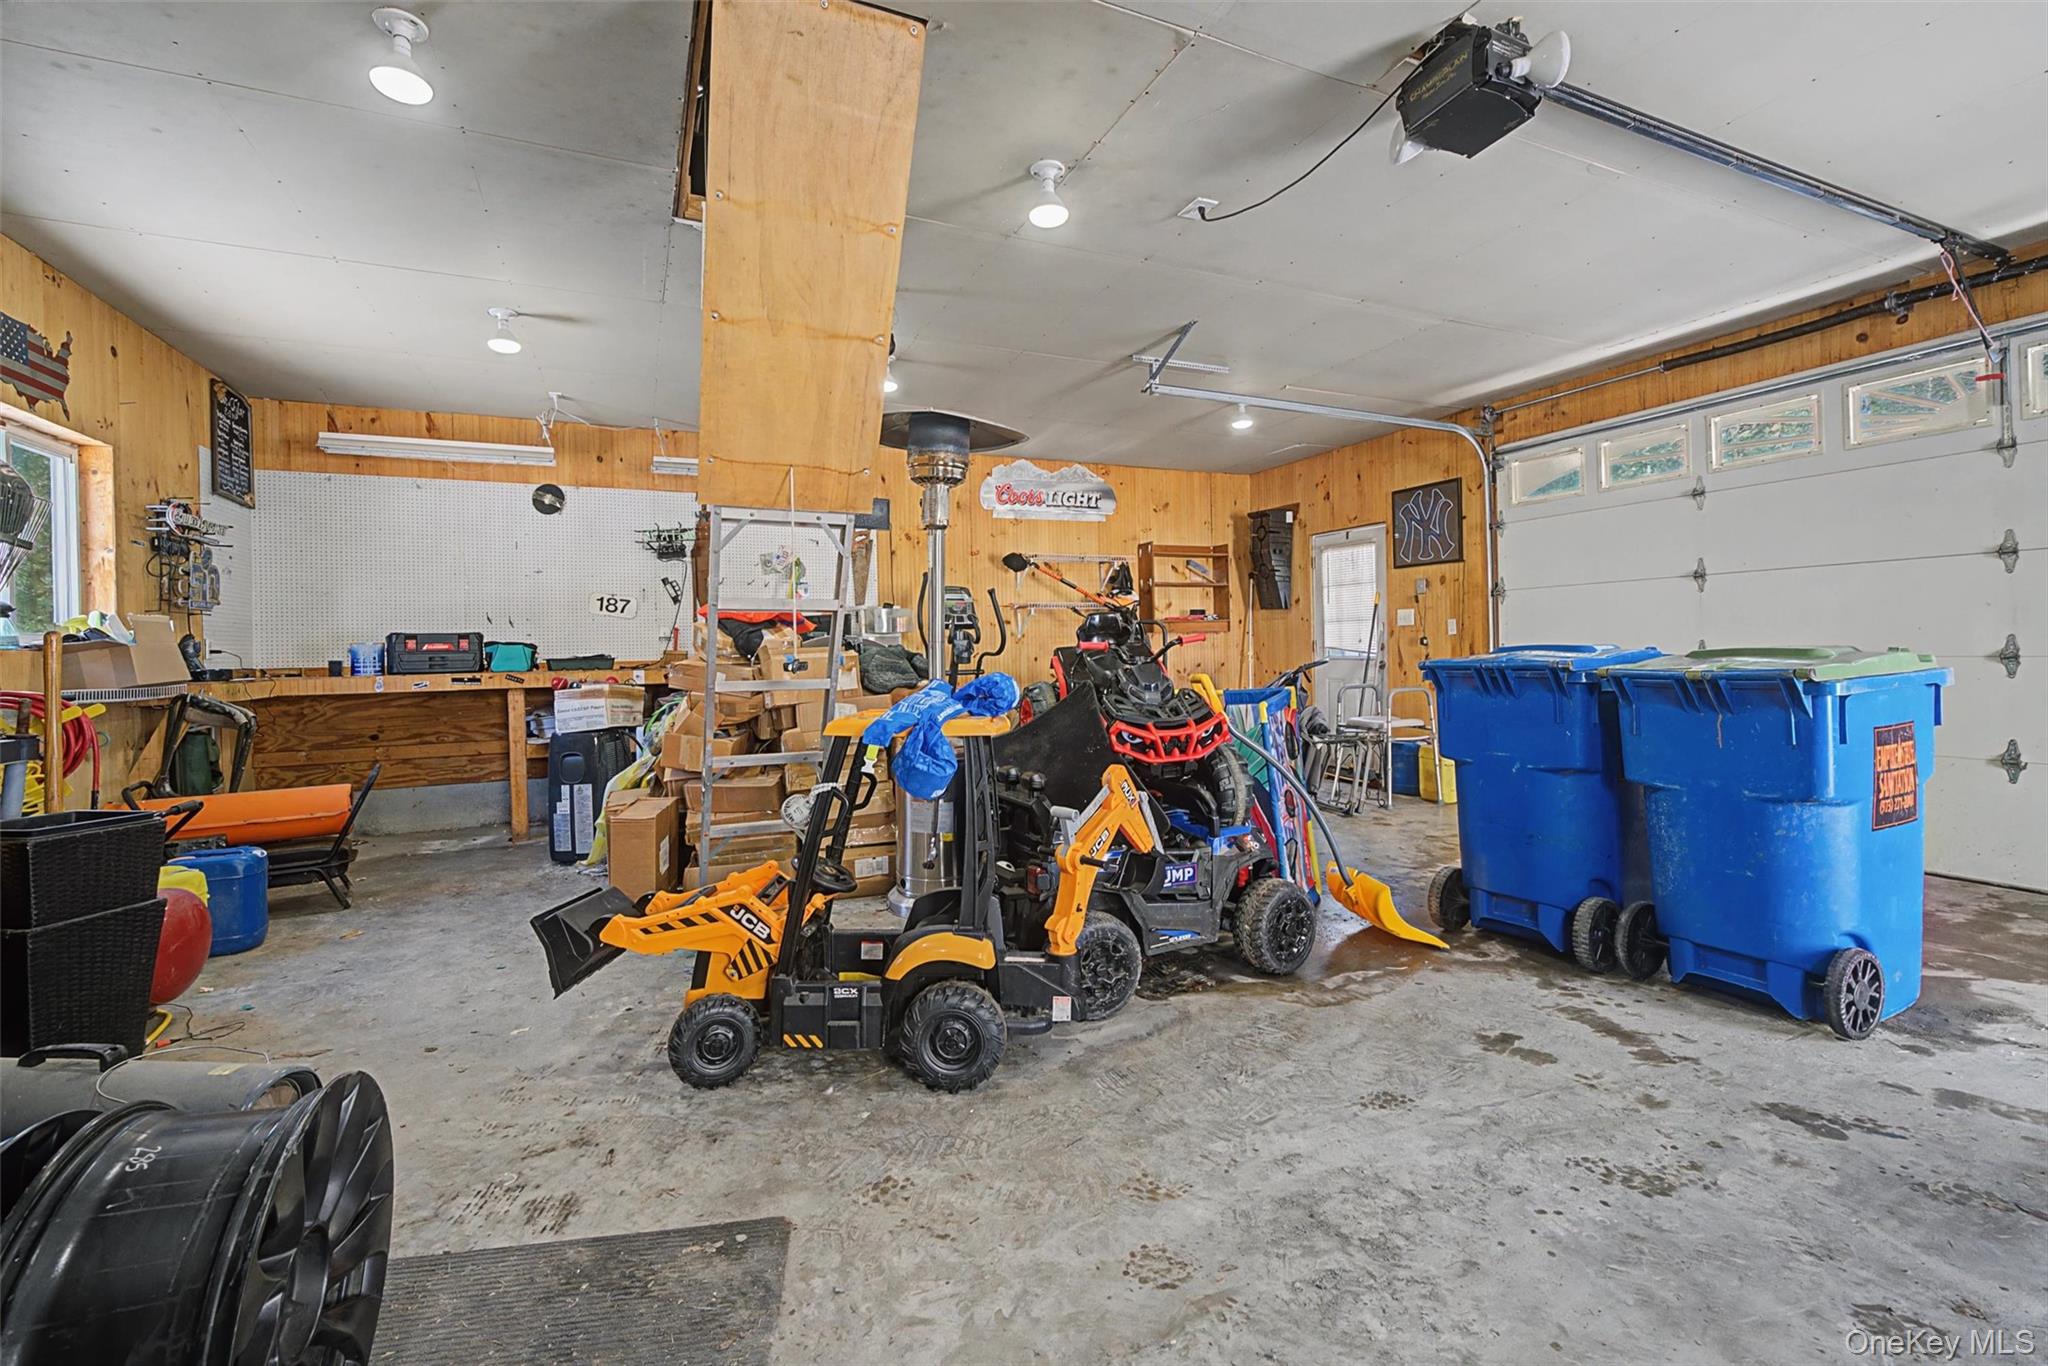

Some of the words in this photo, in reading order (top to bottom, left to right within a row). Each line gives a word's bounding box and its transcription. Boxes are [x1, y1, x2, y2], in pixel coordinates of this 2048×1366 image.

[995, 483, 1045, 506] Coors
[1045, 490, 1102, 509] LIGHT
[596, 597, 631, 614] 187
[730, 908, 770, 939] JCB
